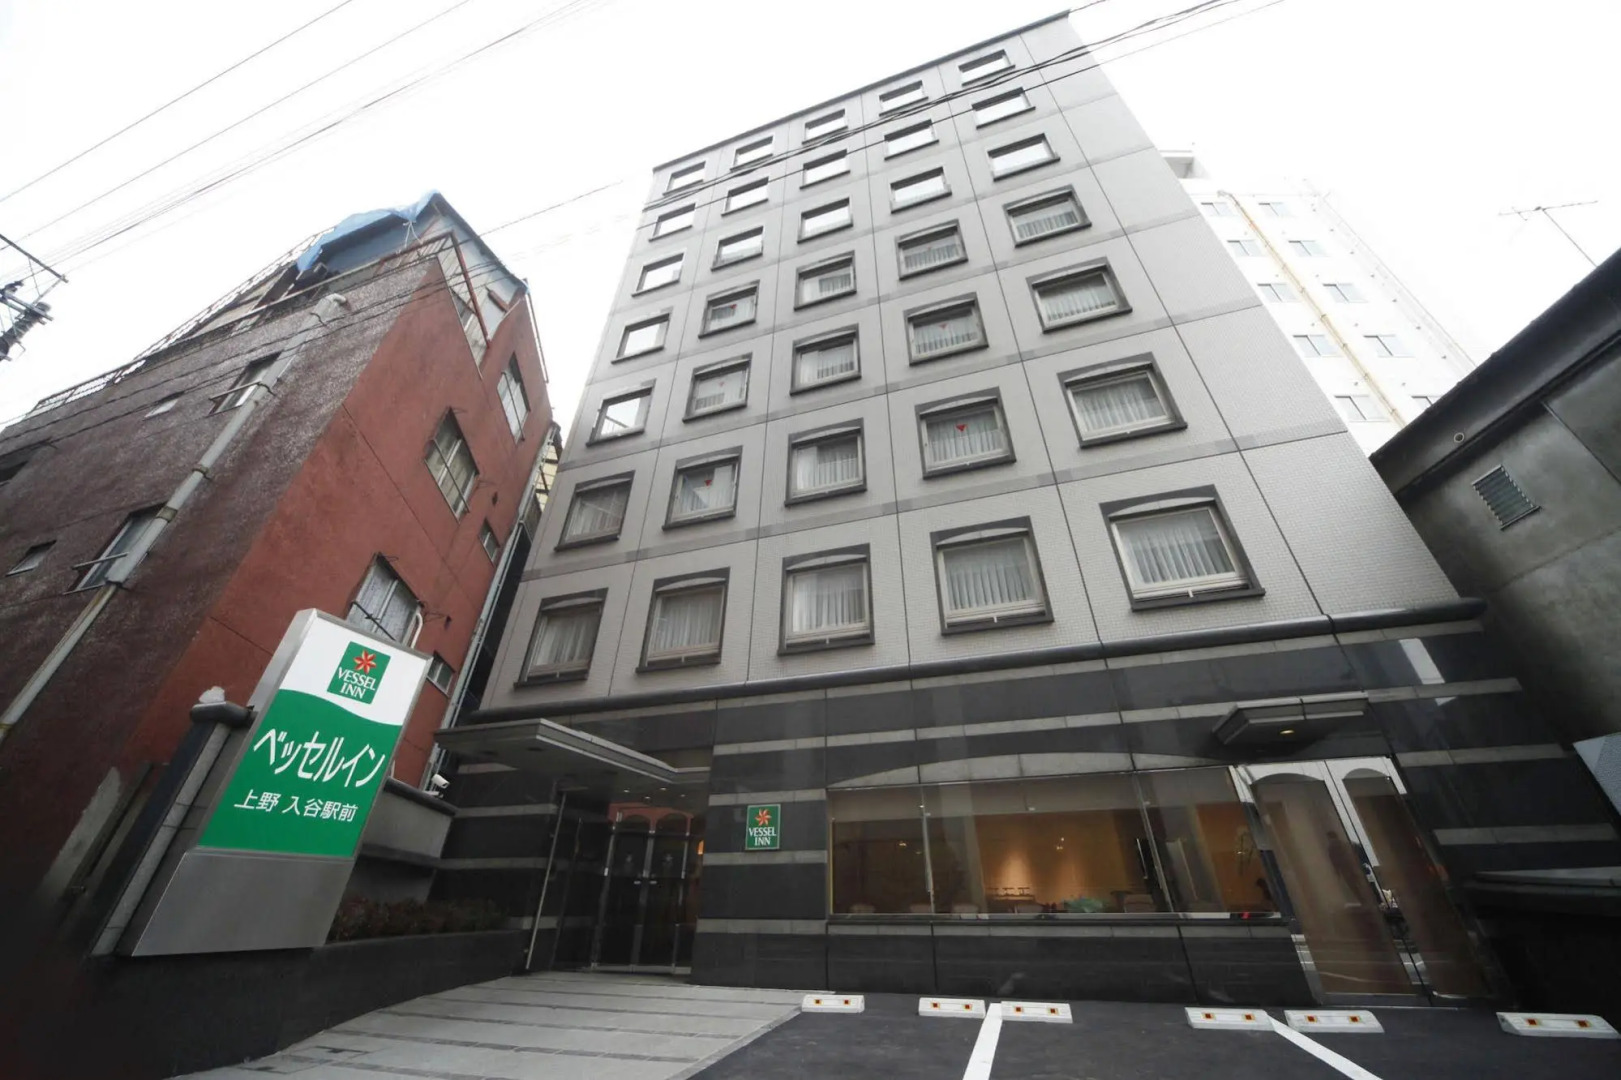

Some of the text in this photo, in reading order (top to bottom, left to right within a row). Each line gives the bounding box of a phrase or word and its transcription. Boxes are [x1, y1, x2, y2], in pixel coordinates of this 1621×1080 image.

[338, 667, 376, 691] VESSEL
[340, 683, 366, 699] INN
[254, 728, 386, 787] ベッセルイン
[234, 789, 358, 822] 上野 入谷駅前
[748, 827, 777, 837] VESSEL
[754, 836, 771, 846] INN
